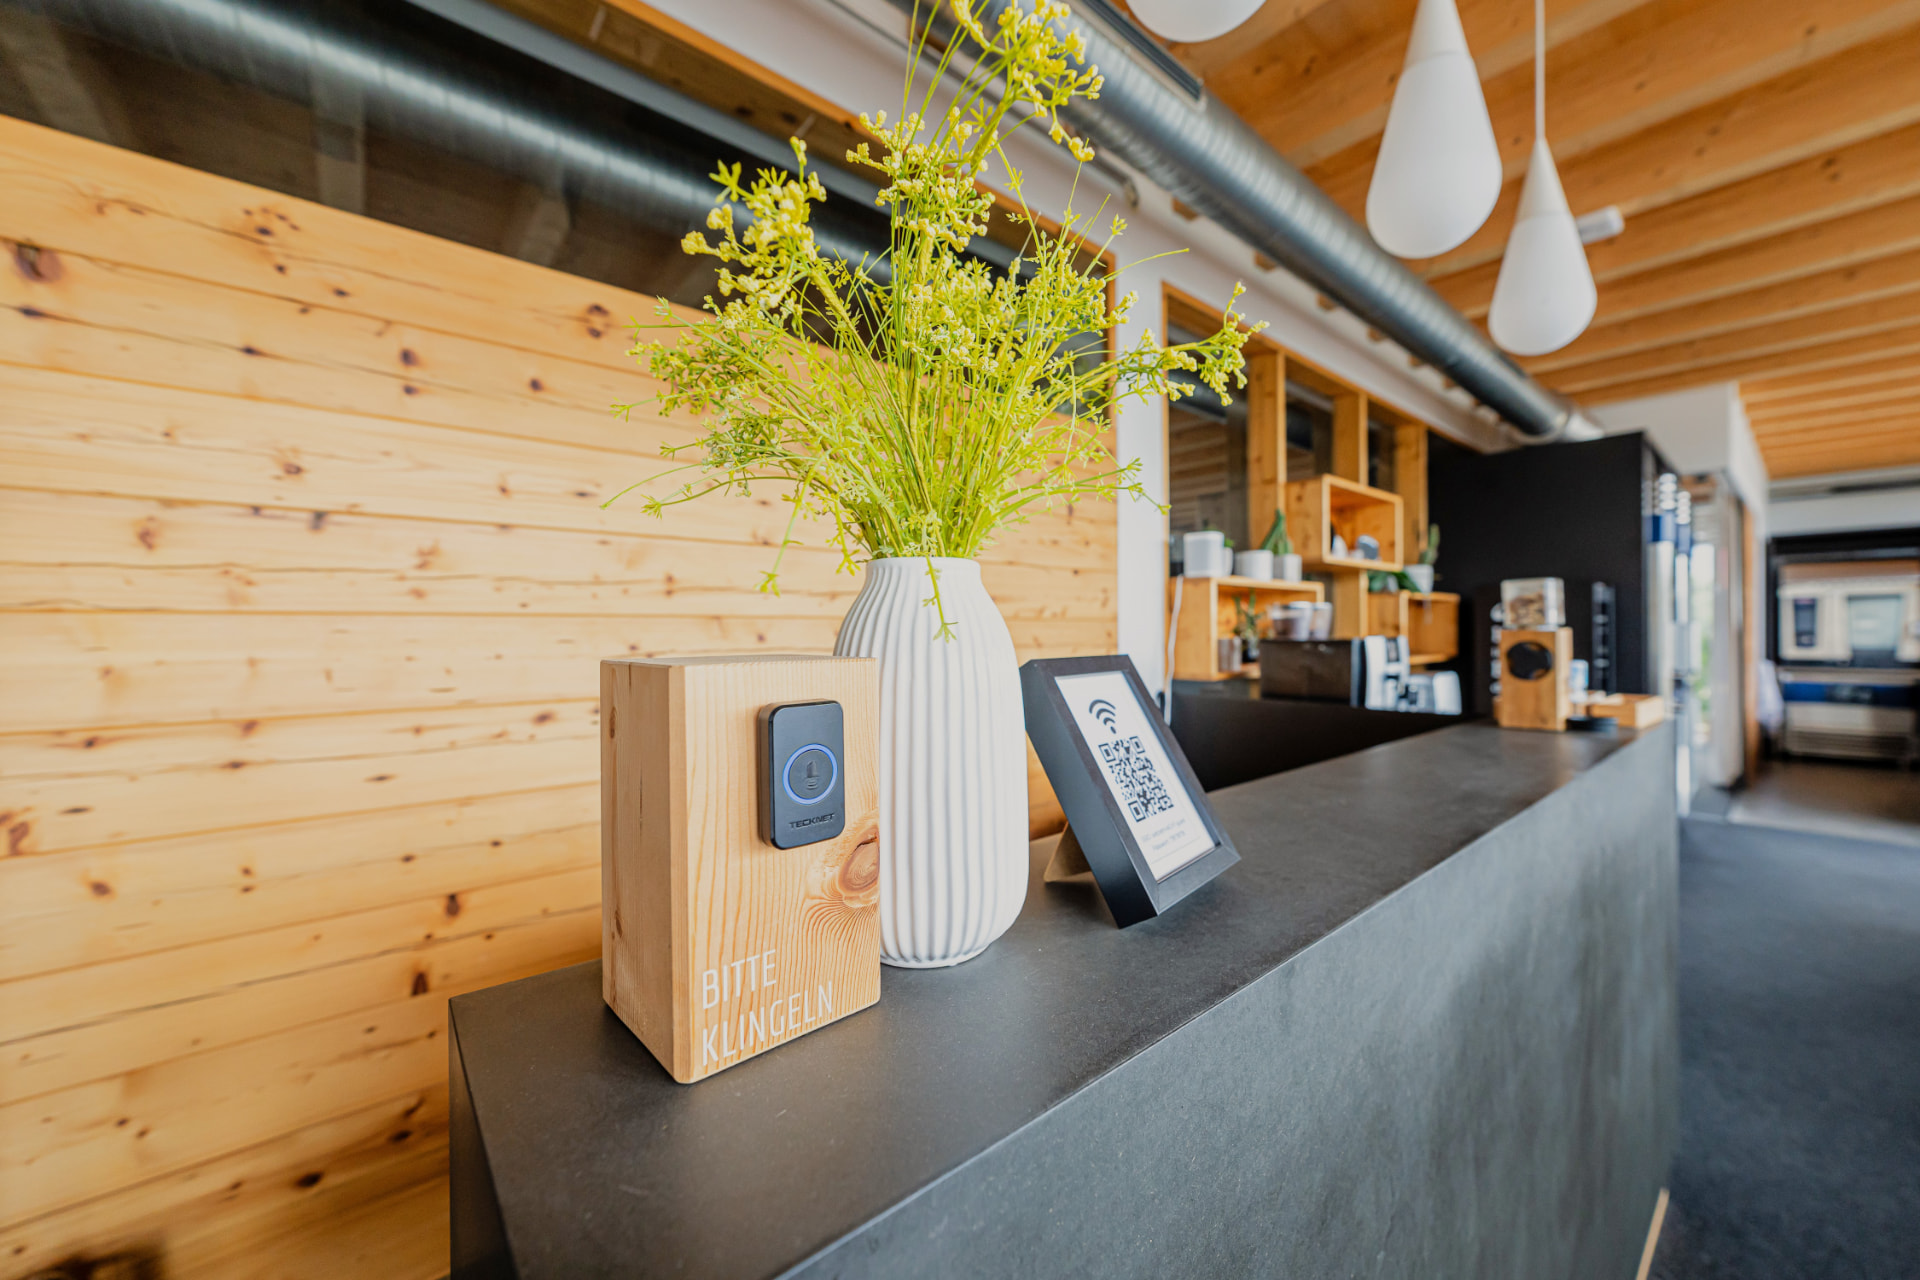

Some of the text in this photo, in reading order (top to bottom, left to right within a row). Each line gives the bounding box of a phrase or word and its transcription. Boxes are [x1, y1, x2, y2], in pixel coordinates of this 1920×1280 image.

[789, 812, 834, 829] TECKNET
[702, 949, 777, 1010] BITTE
[702, 981, 832, 1066] KLINGELN
